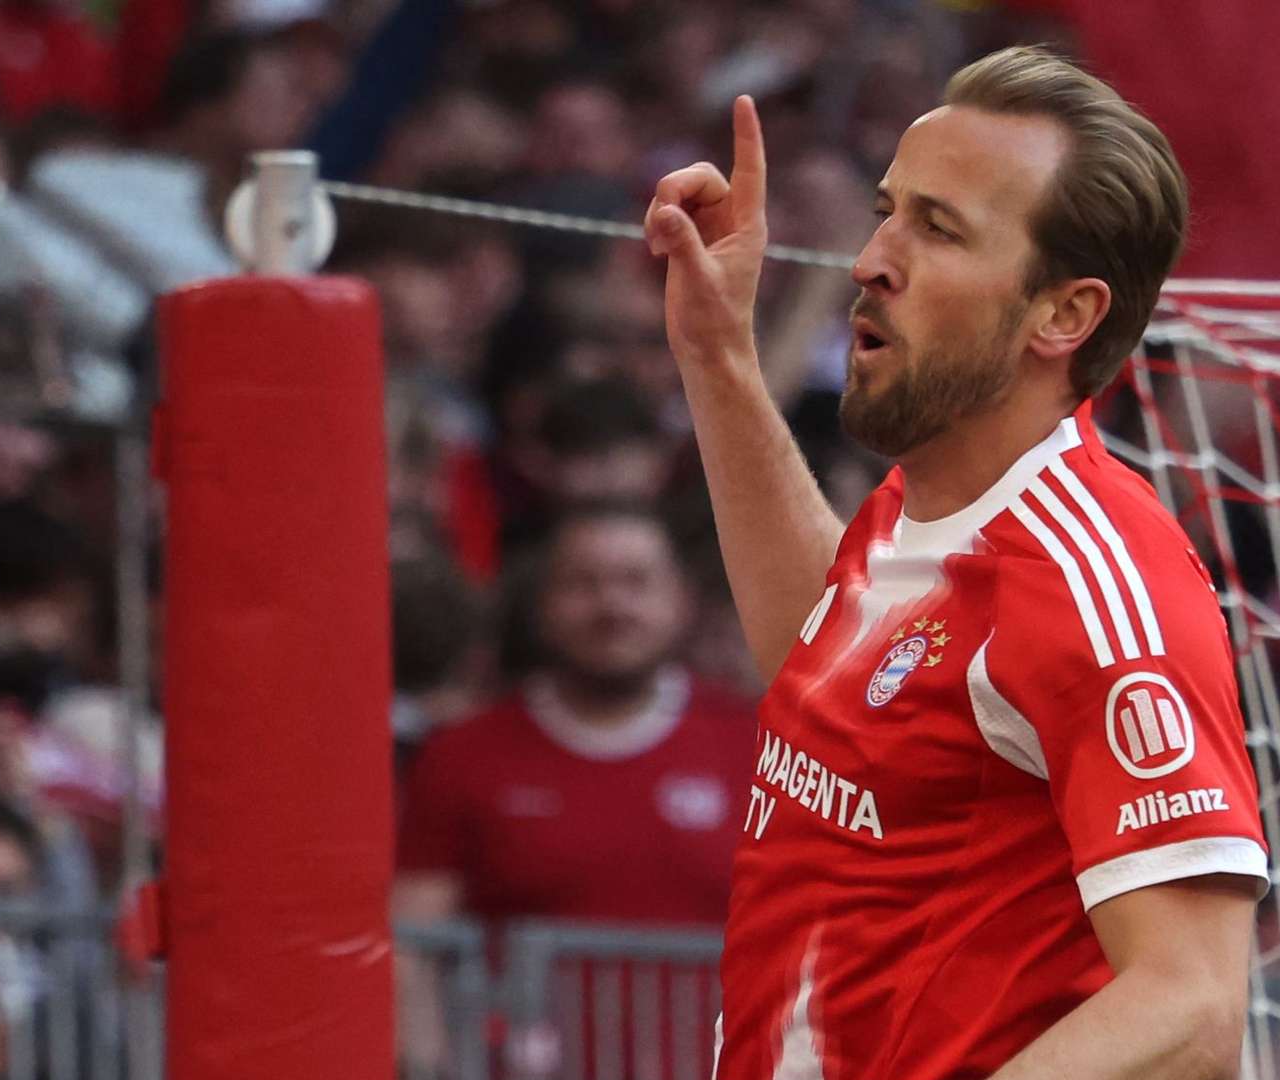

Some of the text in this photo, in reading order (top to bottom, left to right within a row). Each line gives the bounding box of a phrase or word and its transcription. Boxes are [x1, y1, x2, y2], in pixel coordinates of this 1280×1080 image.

[743, 784, 777, 841] TV
[756, 729, 884, 840] MAGENTA
[1115, 787, 1230, 836] Allianz
